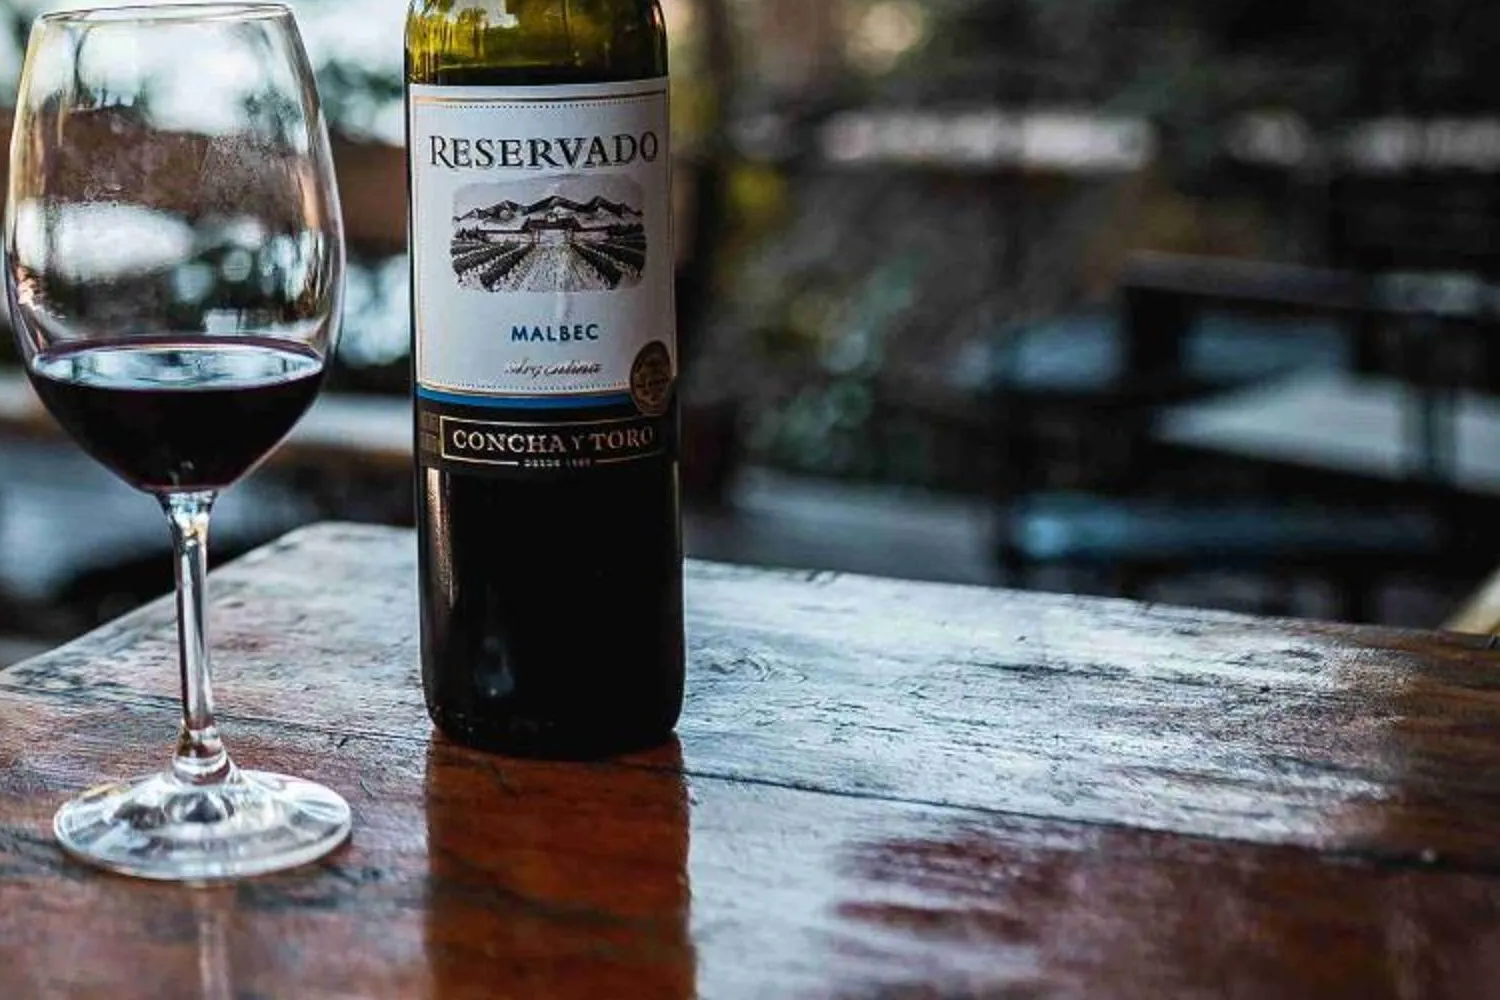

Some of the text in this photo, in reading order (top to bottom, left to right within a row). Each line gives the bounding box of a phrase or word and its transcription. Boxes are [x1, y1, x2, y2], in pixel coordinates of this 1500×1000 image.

[429, 131, 659, 169] RESERVADO
[511, 324, 600, 342] MALBEC
[453, 429, 567, 453] CONCHA
[588, 425, 654, 451] TORO
